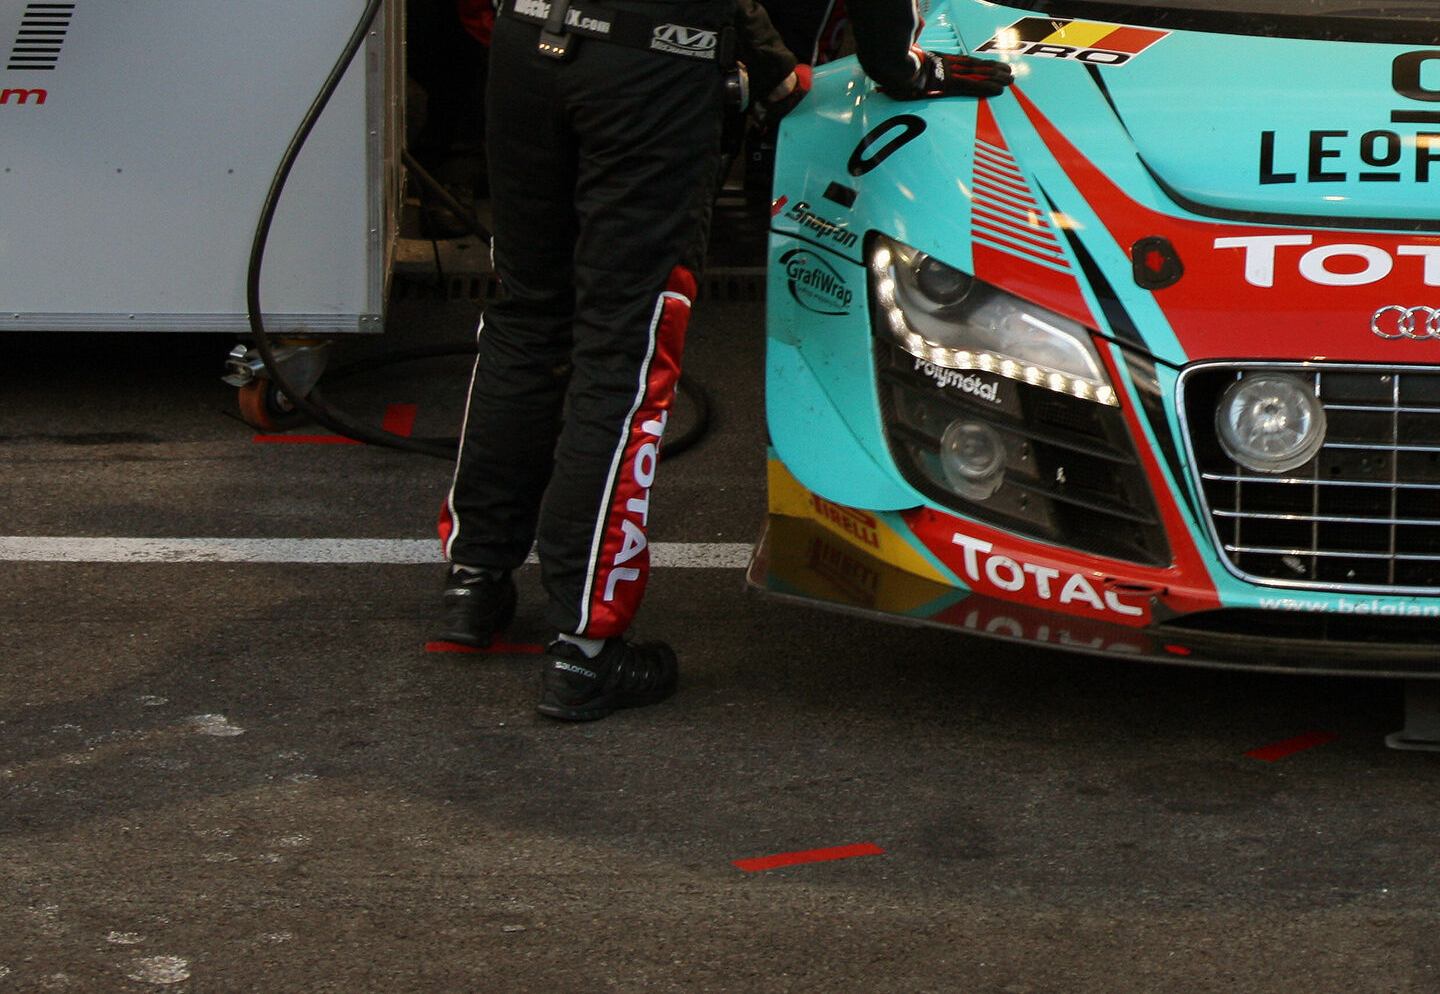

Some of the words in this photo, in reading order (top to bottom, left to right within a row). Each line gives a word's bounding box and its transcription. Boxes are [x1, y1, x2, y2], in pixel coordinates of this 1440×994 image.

[785, 201, 859, 249] Snap-on
[786, 258, 852, 306] GrafiWrap
[603, 409, 668, 602] TOTAL
[951, 532, 1143, 616] TOTAL
